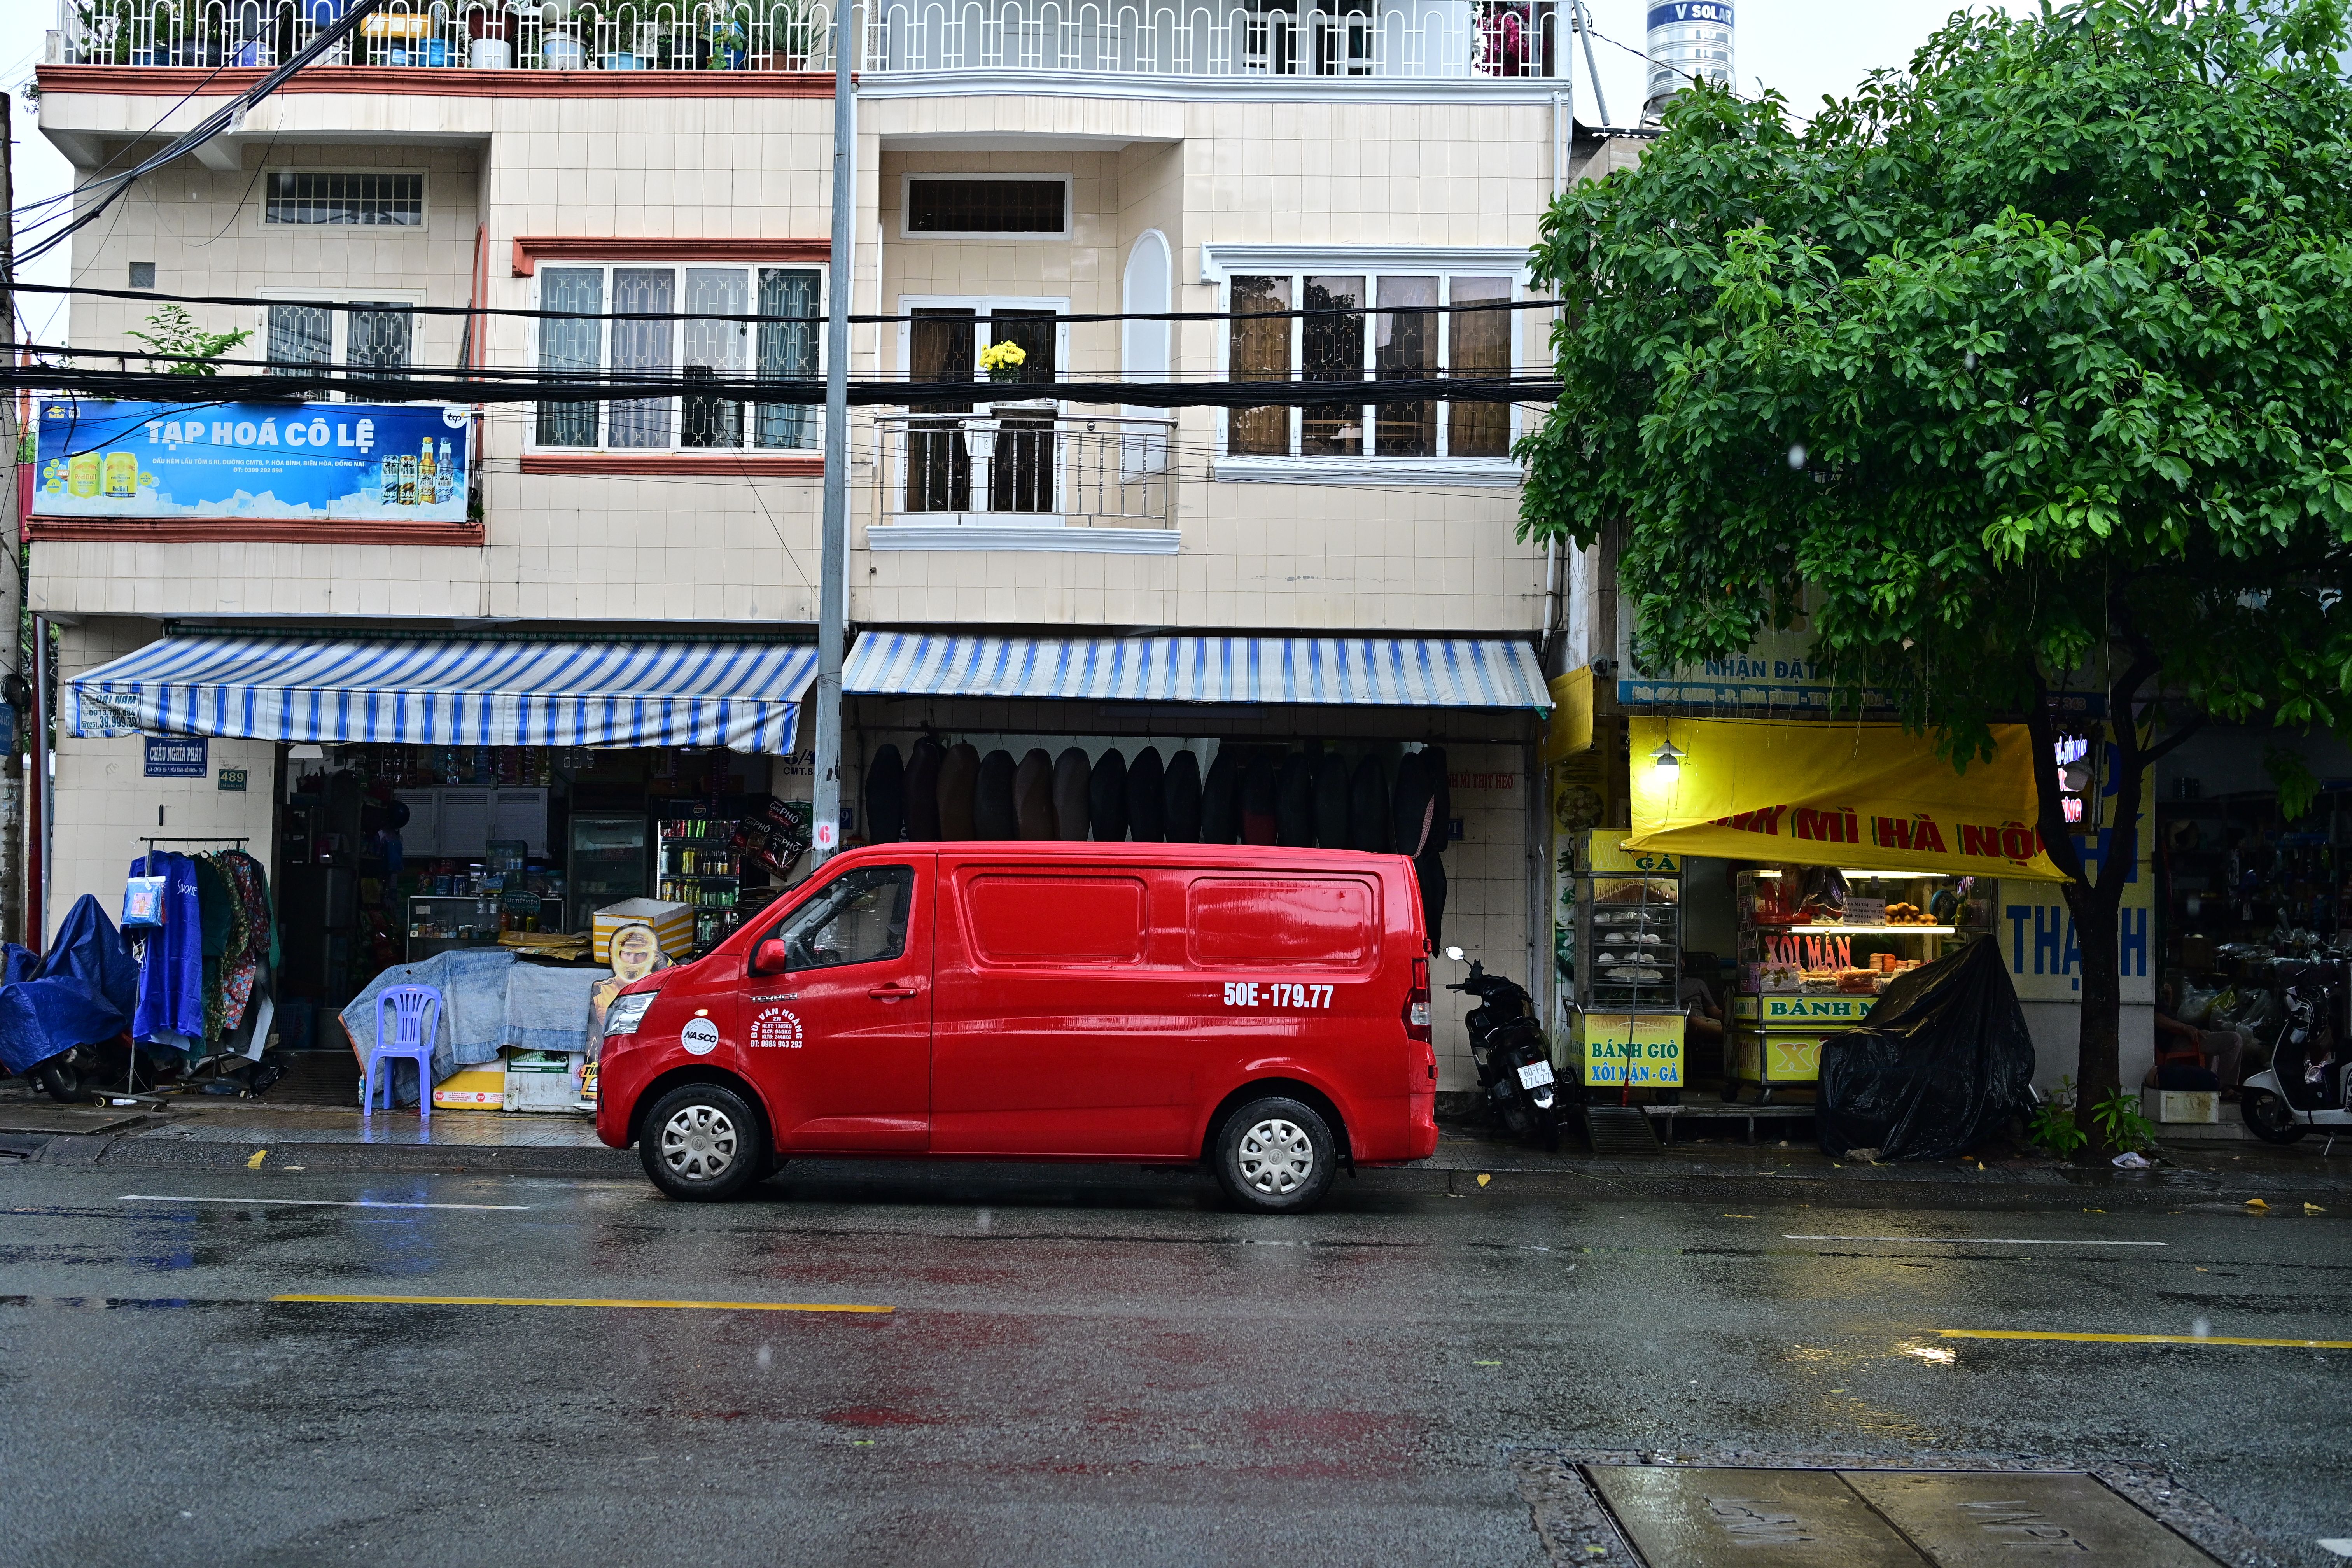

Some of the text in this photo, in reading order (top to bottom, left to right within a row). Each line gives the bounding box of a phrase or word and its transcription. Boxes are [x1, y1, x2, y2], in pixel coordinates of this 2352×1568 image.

[1675, 4, 1732, 24] V SOLAR
[145, 417, 374, 453] TẠP HOÁ CÔ LỆ
[1706, 656, 1766, 680] NHẬN
[114, 695, 136, 704] NAM
[150, 743, 166, 761] CHÂU
[187, 743, 202, 762] PHÁT
[220, 771, 244, 782] 489
[783, 767, 813, 775] CMT.8
[1472, 774, 1493, 791] THỊT
[1496, 774, 1513, 789] HEO
[819, 825, 831, 843] 6
[1791, 806, 1860, 844] MÌ
[1871, 812, 1948, 853] HÀ
[1636, 854, 1676, 870] GÀ
[1765, 927, 1802, 971] XÔI
[1770, 999, 1851, 1015] BÁNH
[683, 1031, 717, 1043] NASCO
[751, 1021, 761, 1038] BÙI
[1591, 1039, 1678, 1058] BÁNH GIÒ
[1523, 1064, 1545, 1077] 60-F4
[1591, 1061, 1615, 1081] XÔI
[1619, 1062, 1649, 1084] MẶN
[1659, 1062, 1678, 1081] GÀ
[1524, 1072, 1550, 1088] 274.27
